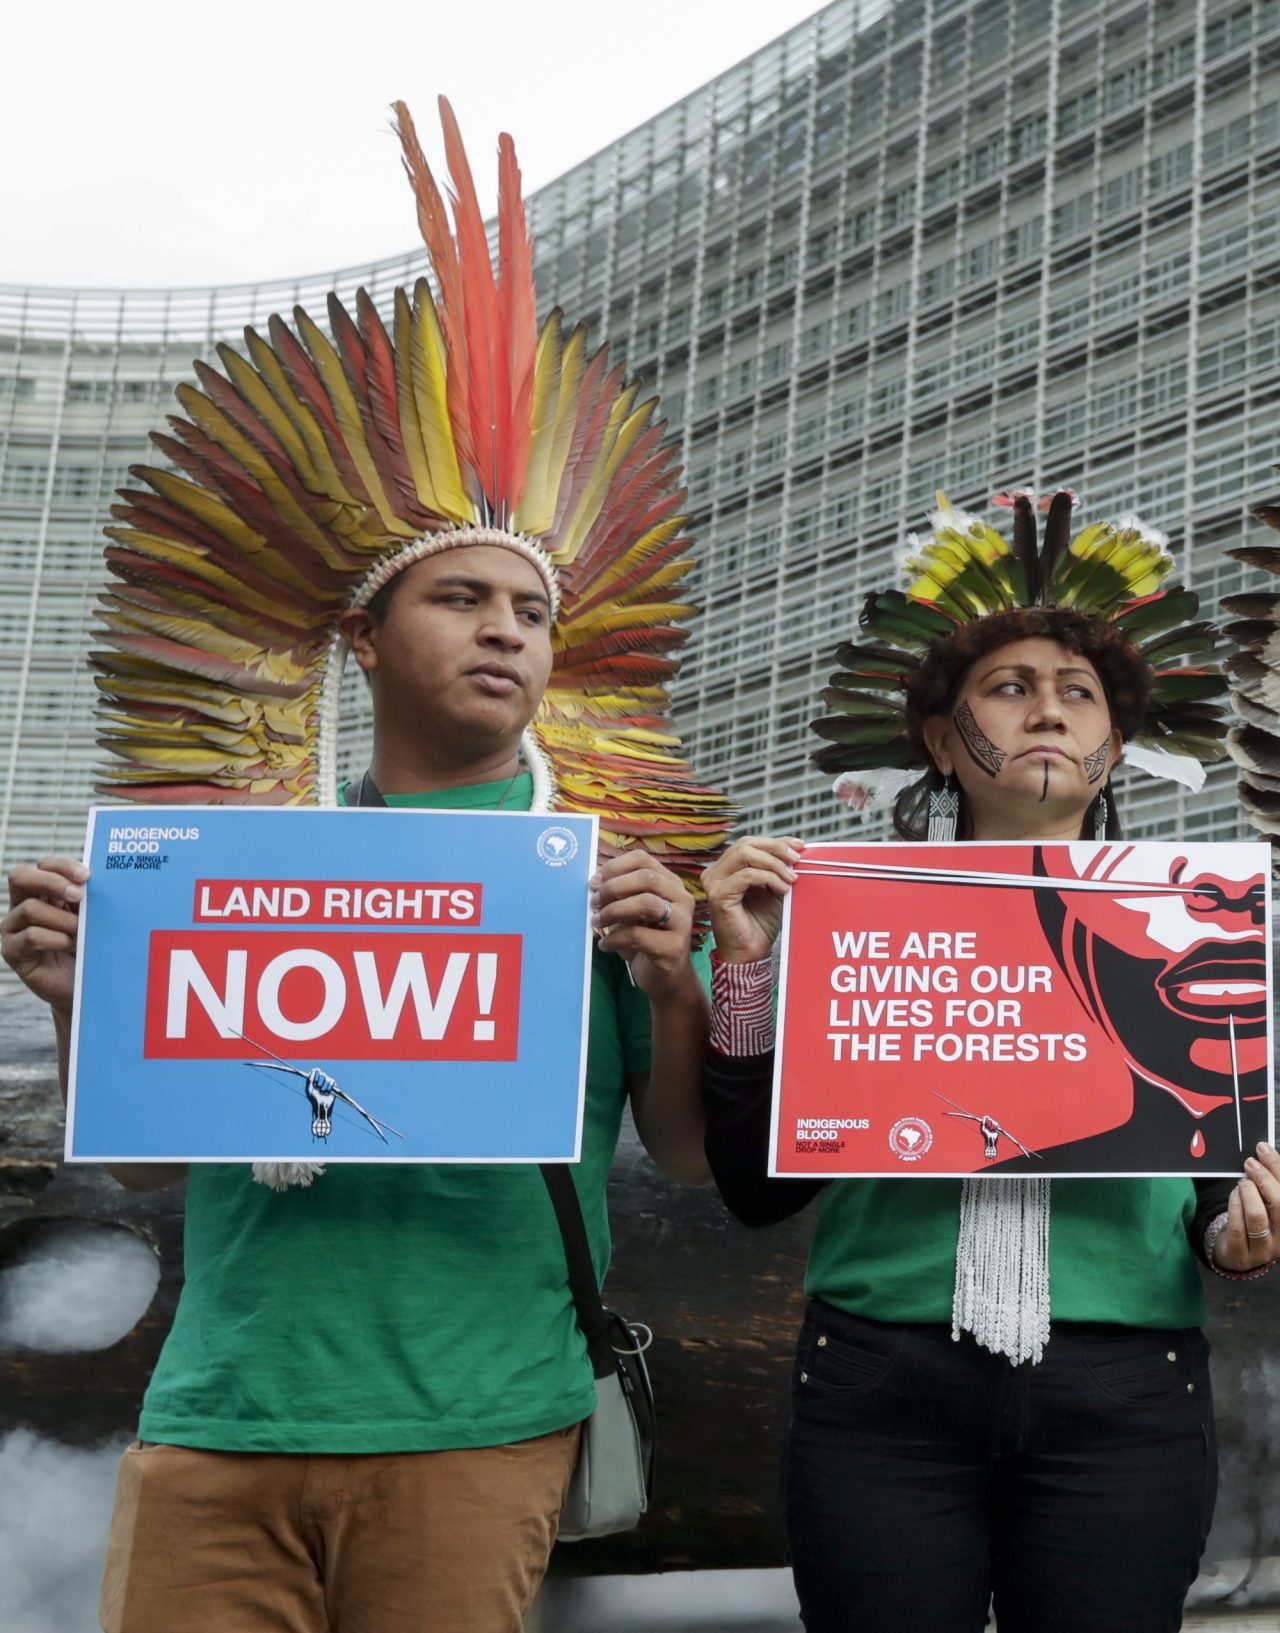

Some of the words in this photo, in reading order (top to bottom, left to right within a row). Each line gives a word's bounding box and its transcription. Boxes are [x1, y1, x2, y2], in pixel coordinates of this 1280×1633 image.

[110, 827, 200, 840] INDIGENOUS
[108, 841, 160, 853] BLOOD
[106, 855, 126, 863] NOT
[128, 855, 134, 863] A
[136, 855, 169, 863] SINGLE
[106, 862, 133, 870] DROP
[134, 862, 162, 870] MORE
[200, 887, 311, 917] LAND
[323, 888, 475, 920] RIGHTS
[831, 931, 890, 959] WE
[900, 932, 977, 959] ARE
[830, 965, 959, 993] GIVING
[970, 965, 1052, 993] OUR
[165, 947, 498, 1042] NOW!
[829, 999, 933, 1027] LIVES
[945, 999, 1021, 1027] FOR
[826, 1033, 901, 1061] THE
[913, 1033, 1087, 1062] FORESTS
[797, 1118, 870, 1129] INDIGENOUS
[796, 1130, 838, 1140] BLOOD
